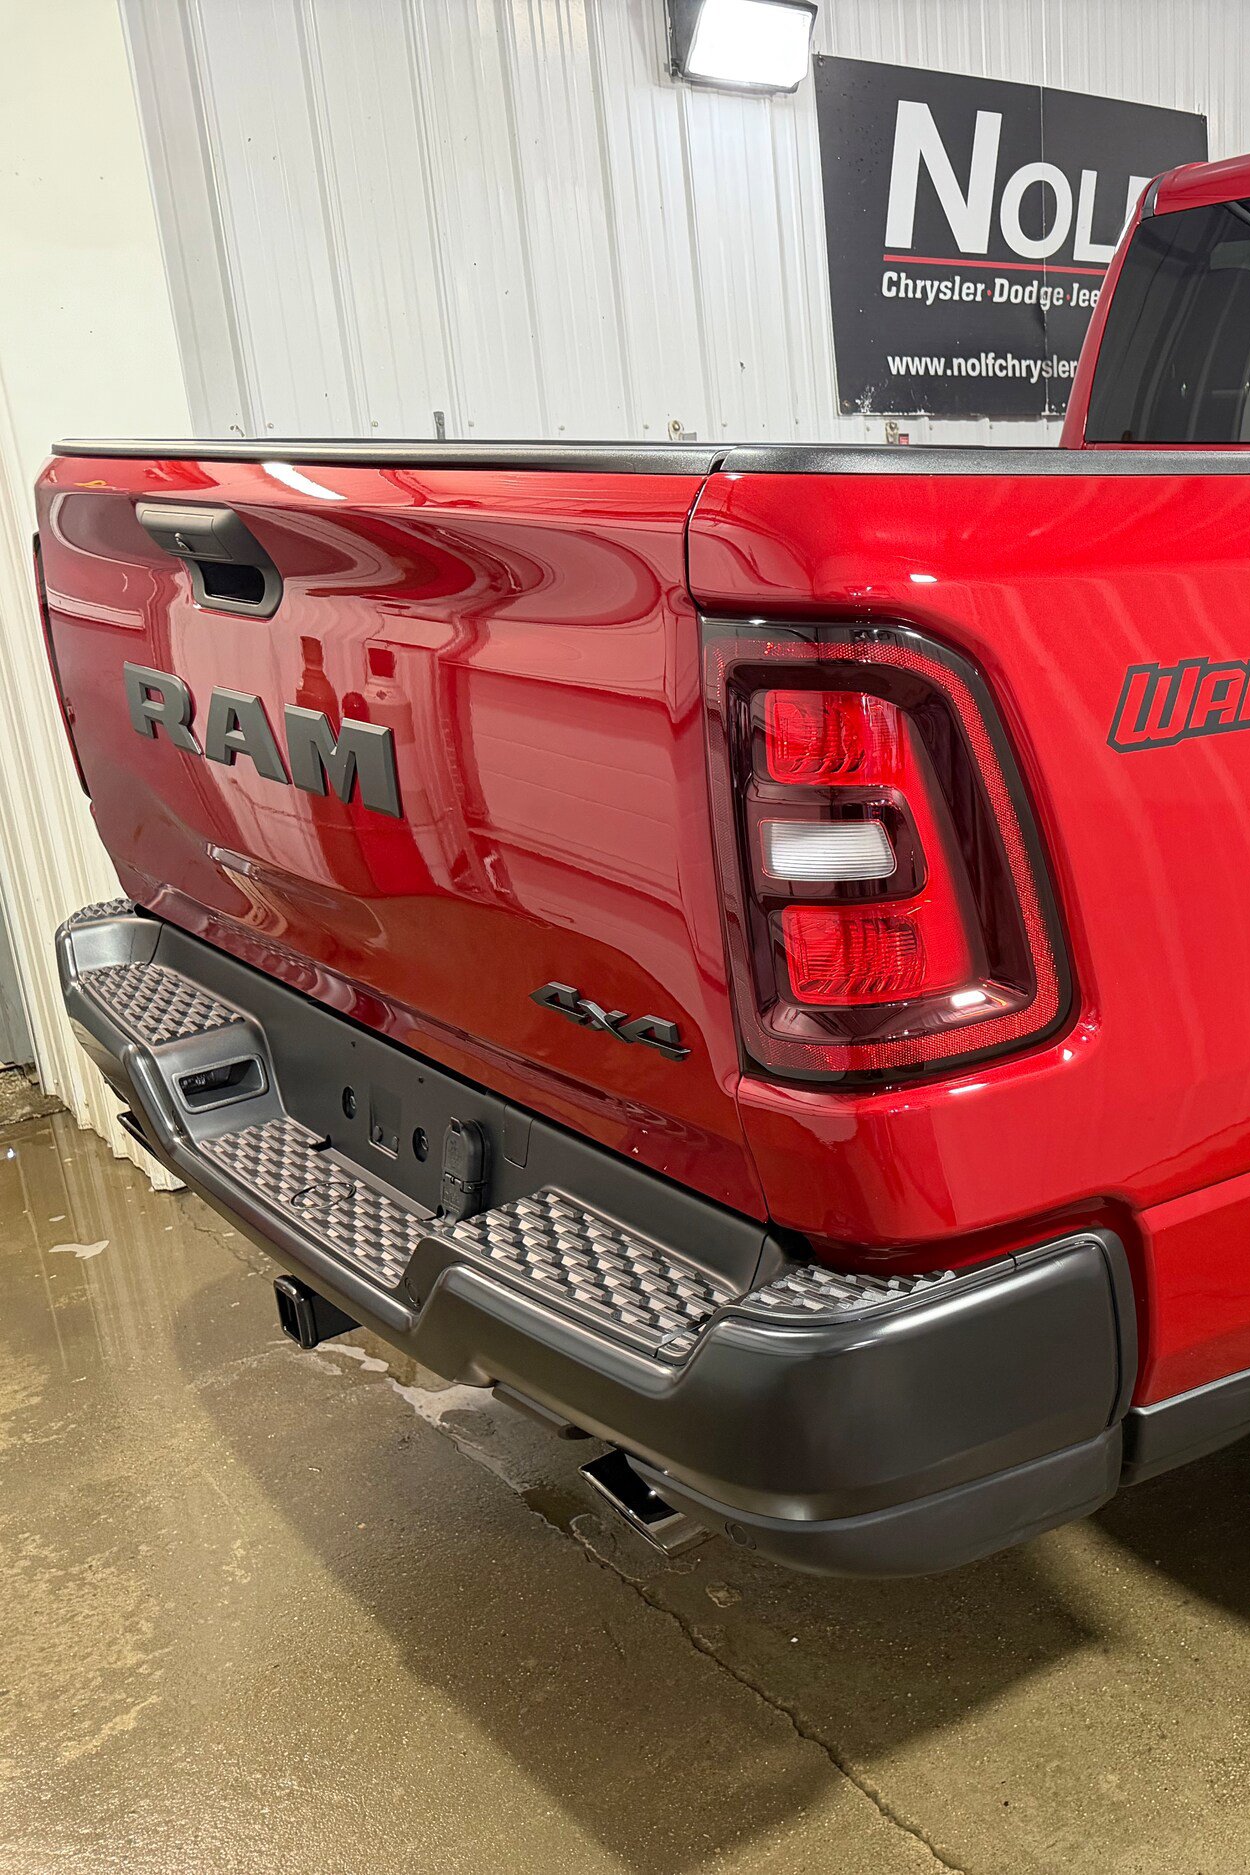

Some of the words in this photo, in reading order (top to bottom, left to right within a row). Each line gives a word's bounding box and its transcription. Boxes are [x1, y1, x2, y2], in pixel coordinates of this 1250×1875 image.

[882, 271, 986, 306] Chrysler
[992, 278, 1064, 311] Dodge
[1070, 283, 1101, 308] Jee
[887, 353, 1079, 384] www.nolfchrysler
[123, 661, 404, 818] RAM
